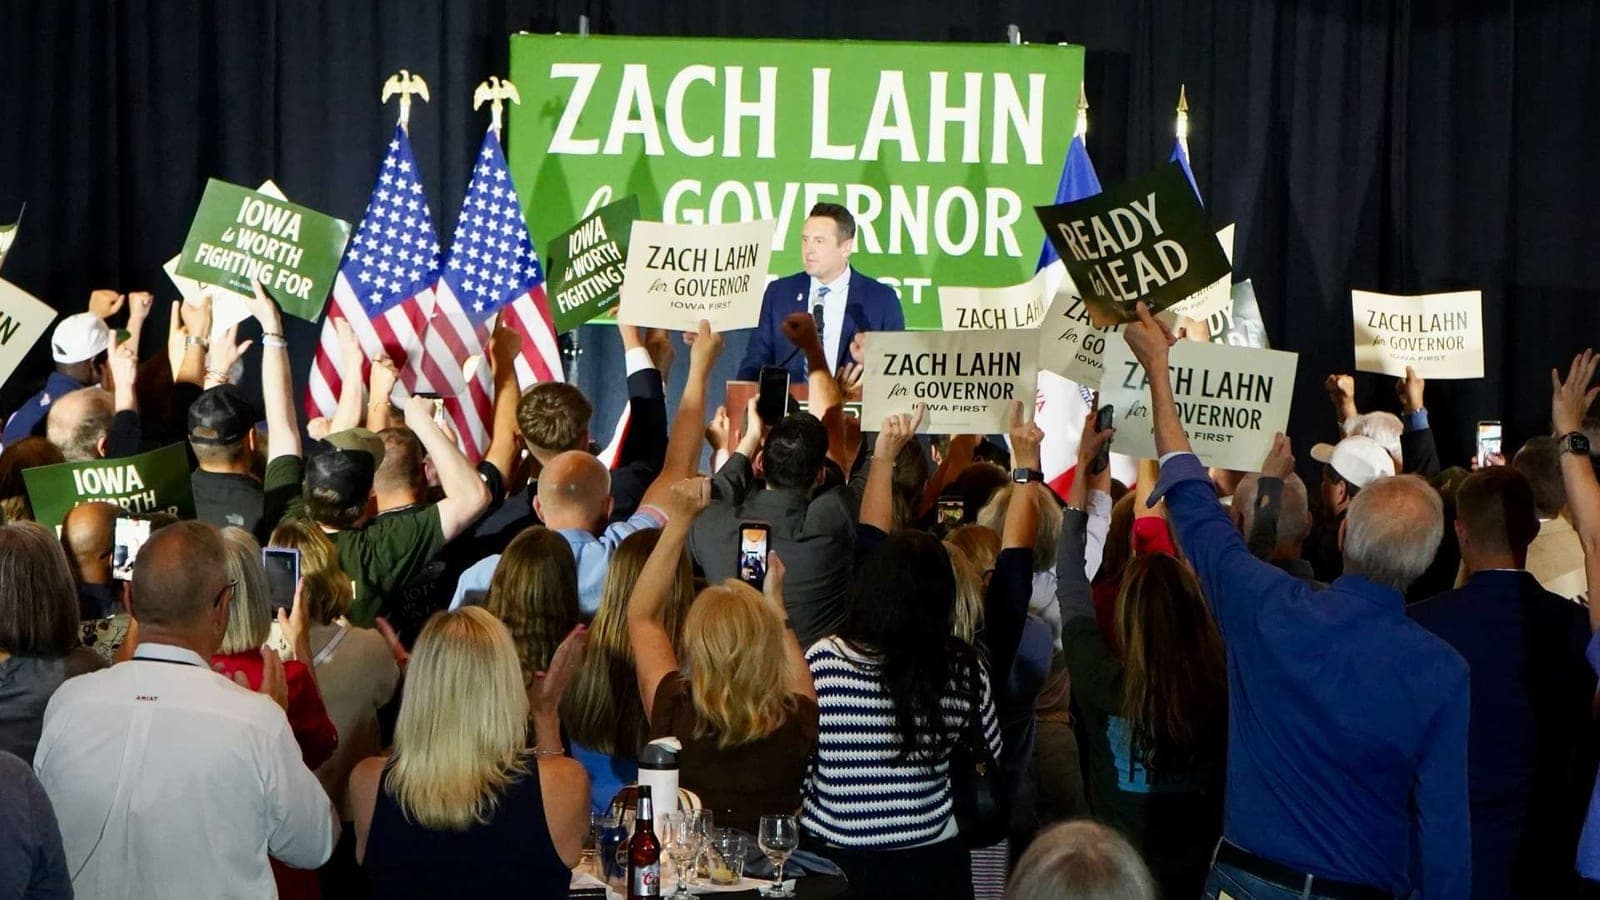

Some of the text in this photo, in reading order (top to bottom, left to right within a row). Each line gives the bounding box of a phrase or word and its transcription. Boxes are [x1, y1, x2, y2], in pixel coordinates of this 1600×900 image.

[547, 63, 1047, 165] ZACH LAHN
[236, 196, 303, 243] IOWA
[1057, 192, 1164, 261] READY
[236, 227, 304, 269] WORTH
[568, 215, 607, 259] IOWA
[194, 242, 314, 300] FIGHTING FOR
[572, 240, 622, 279] WORTH
[645, 245, 706, 273] ZACH
[714, 243, 759, 272] LAHN
[1094, 239, 1189, 301] LEAD
[556, 265, 622, 314] FIGHTING
[647, 276, 668, 294] for
[674, 274, 750, 298] GOVERNOR
[670, 300, 732, 311] IOWA FIRST
[956, 308, 1007, 329] ZACH
[1367, 309, 1467, 333] ZACH LAHN
[1057, 327, 1079, 344] for
[1389, 335, 1465, 351] GOVERNOR
[883, 351, 1021, 377] ZACH LAHN
[887, 381, 1014, 400] for GOVERNOR
[1201, 369, 1274, 404] LAHN
[911, 402, 989, 413] IWA FIRST
[1124, 399, 1148, 420] for
[1194, 431, 1234, 443] FIRST
[72, 464, 145, 496] IOWA
[86, 489, 157, 514] RTH
